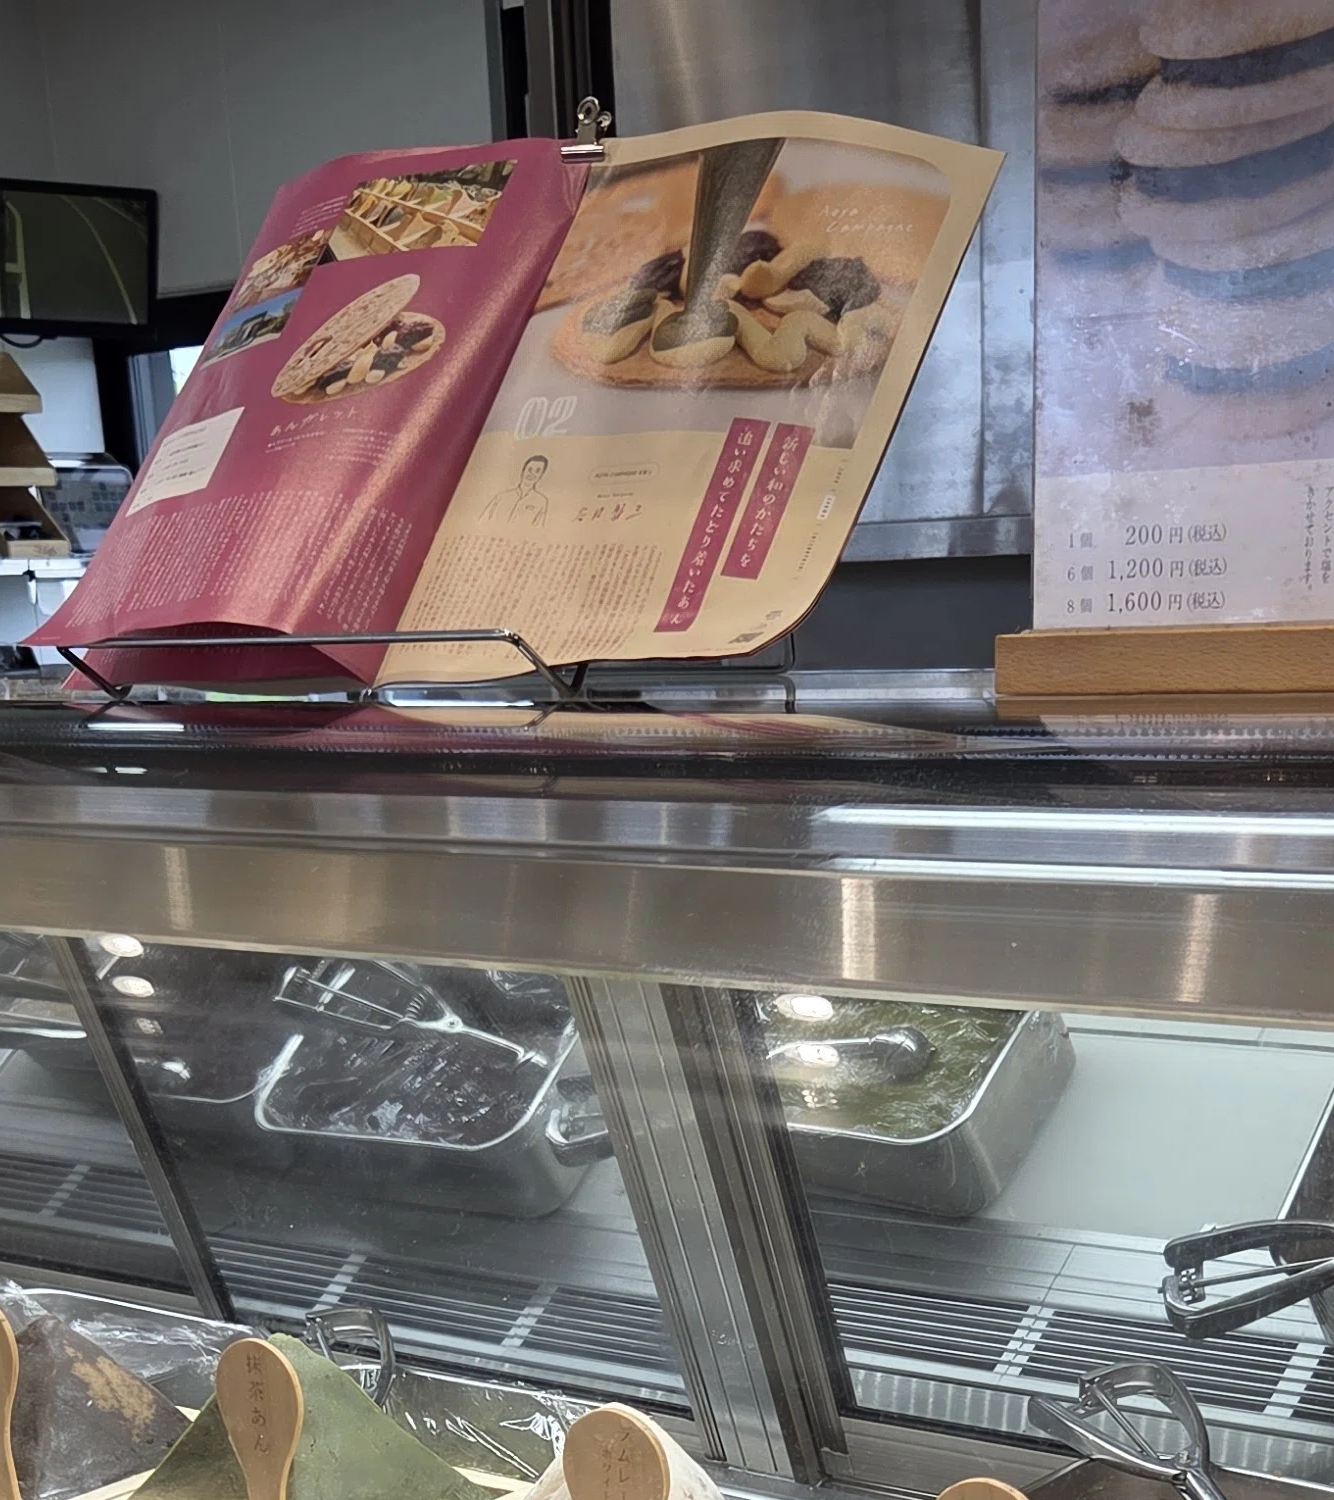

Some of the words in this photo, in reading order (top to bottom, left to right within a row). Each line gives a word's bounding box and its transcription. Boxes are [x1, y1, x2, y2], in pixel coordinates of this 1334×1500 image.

[670, 431, 754, 626] 追い求めてたどり着いたあん
[739, 435, 800, 568] 新しい和のかたちを
[245, 1354, 269, 1453] 抹茶あん
